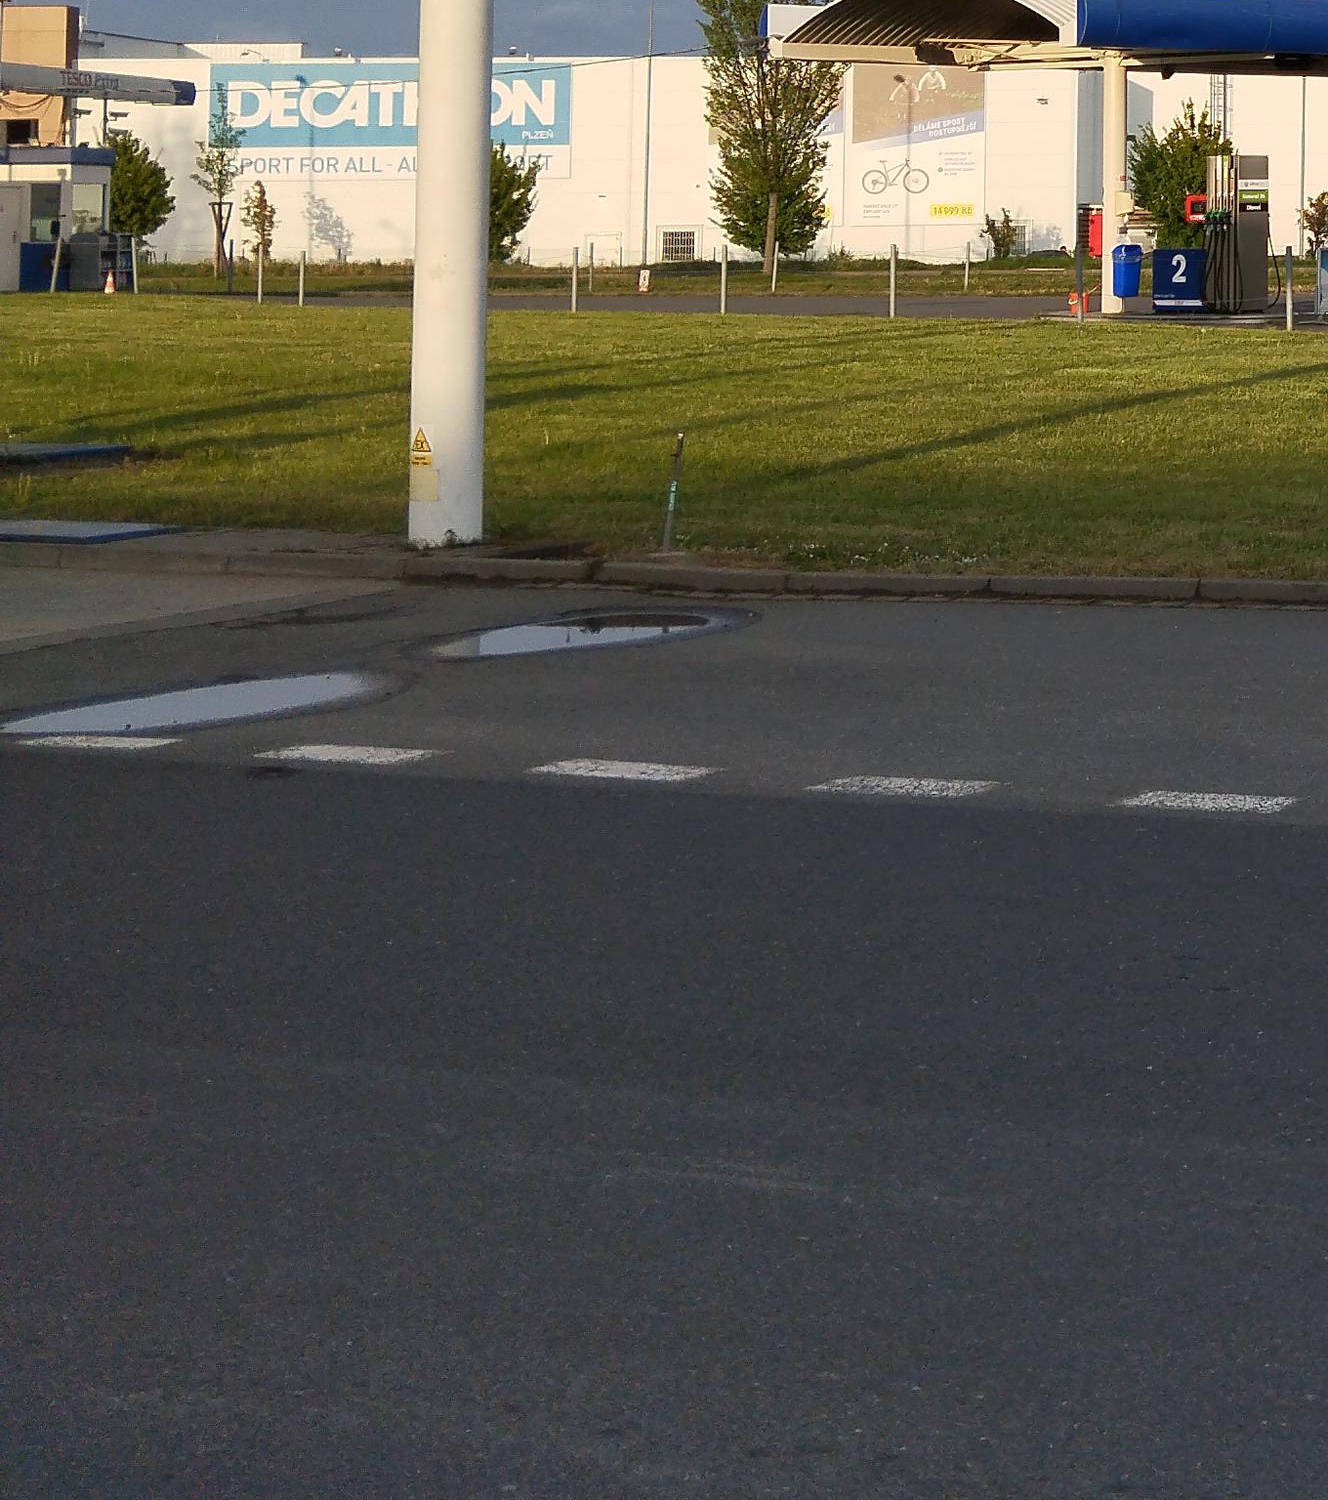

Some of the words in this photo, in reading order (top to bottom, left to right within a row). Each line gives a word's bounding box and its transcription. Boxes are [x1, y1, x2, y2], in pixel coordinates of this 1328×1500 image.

[300, 156, 339, 174] FOR
[344, 156, 382, 173] ALL
[1171, 254, 1187, 283] 2
